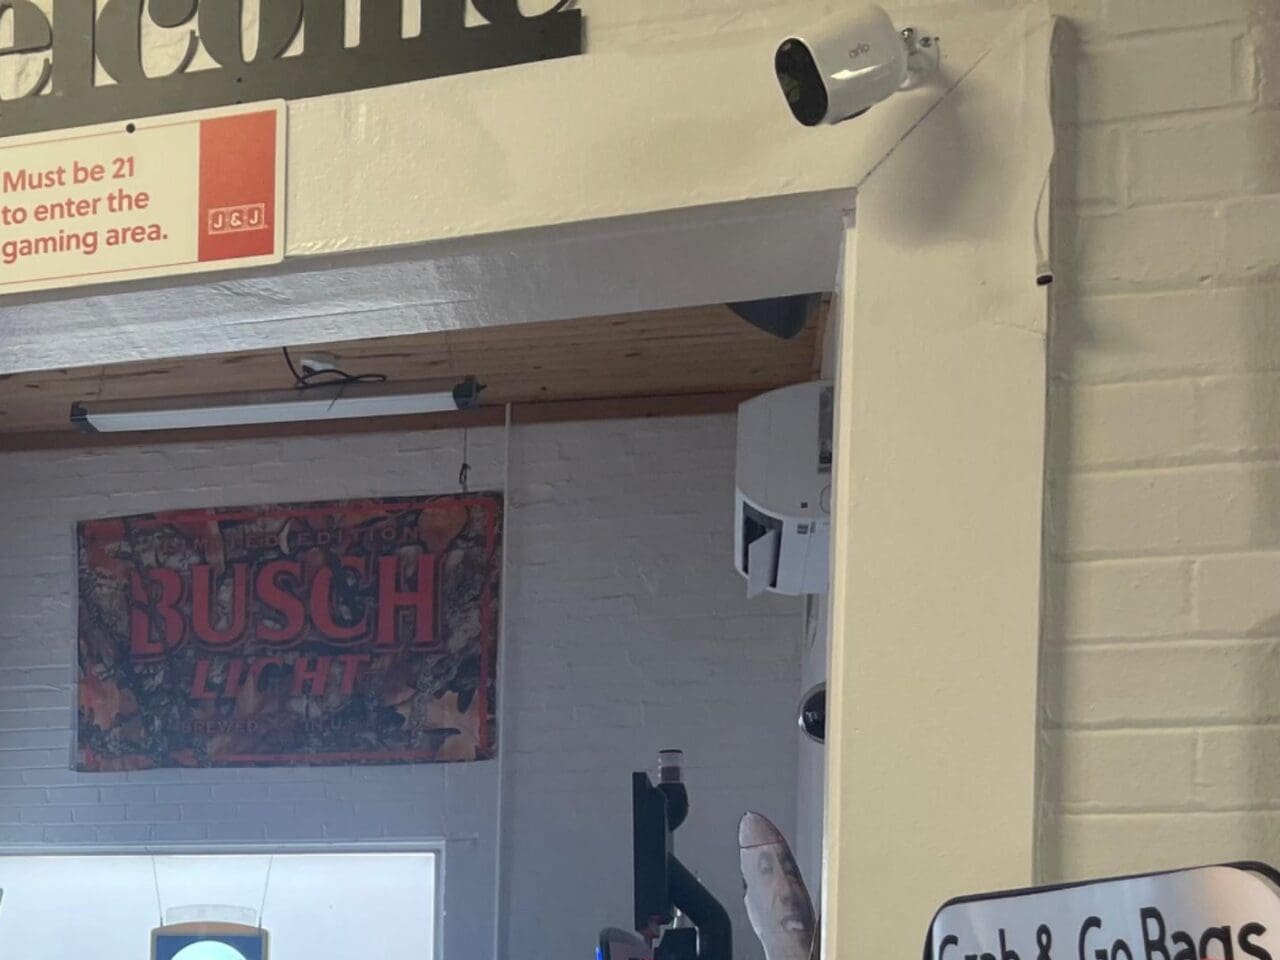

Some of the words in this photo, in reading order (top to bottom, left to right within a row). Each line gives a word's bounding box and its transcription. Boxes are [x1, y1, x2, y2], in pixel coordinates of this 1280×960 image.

[2, 166, 66, 193] Must
[73, 160, 106, 185] be
[112, 156, 135, 179] 21
[1, 205, 28, 225] to
[33, 197, 102, 222] enter
[107, 188, 150, 213] the
[1, 229, 98, 264] gaming
[105, 222, 168, 246] area.
[297, 527, 420, 546] EDITION
[129, 552, 438, 657] BUSCH
